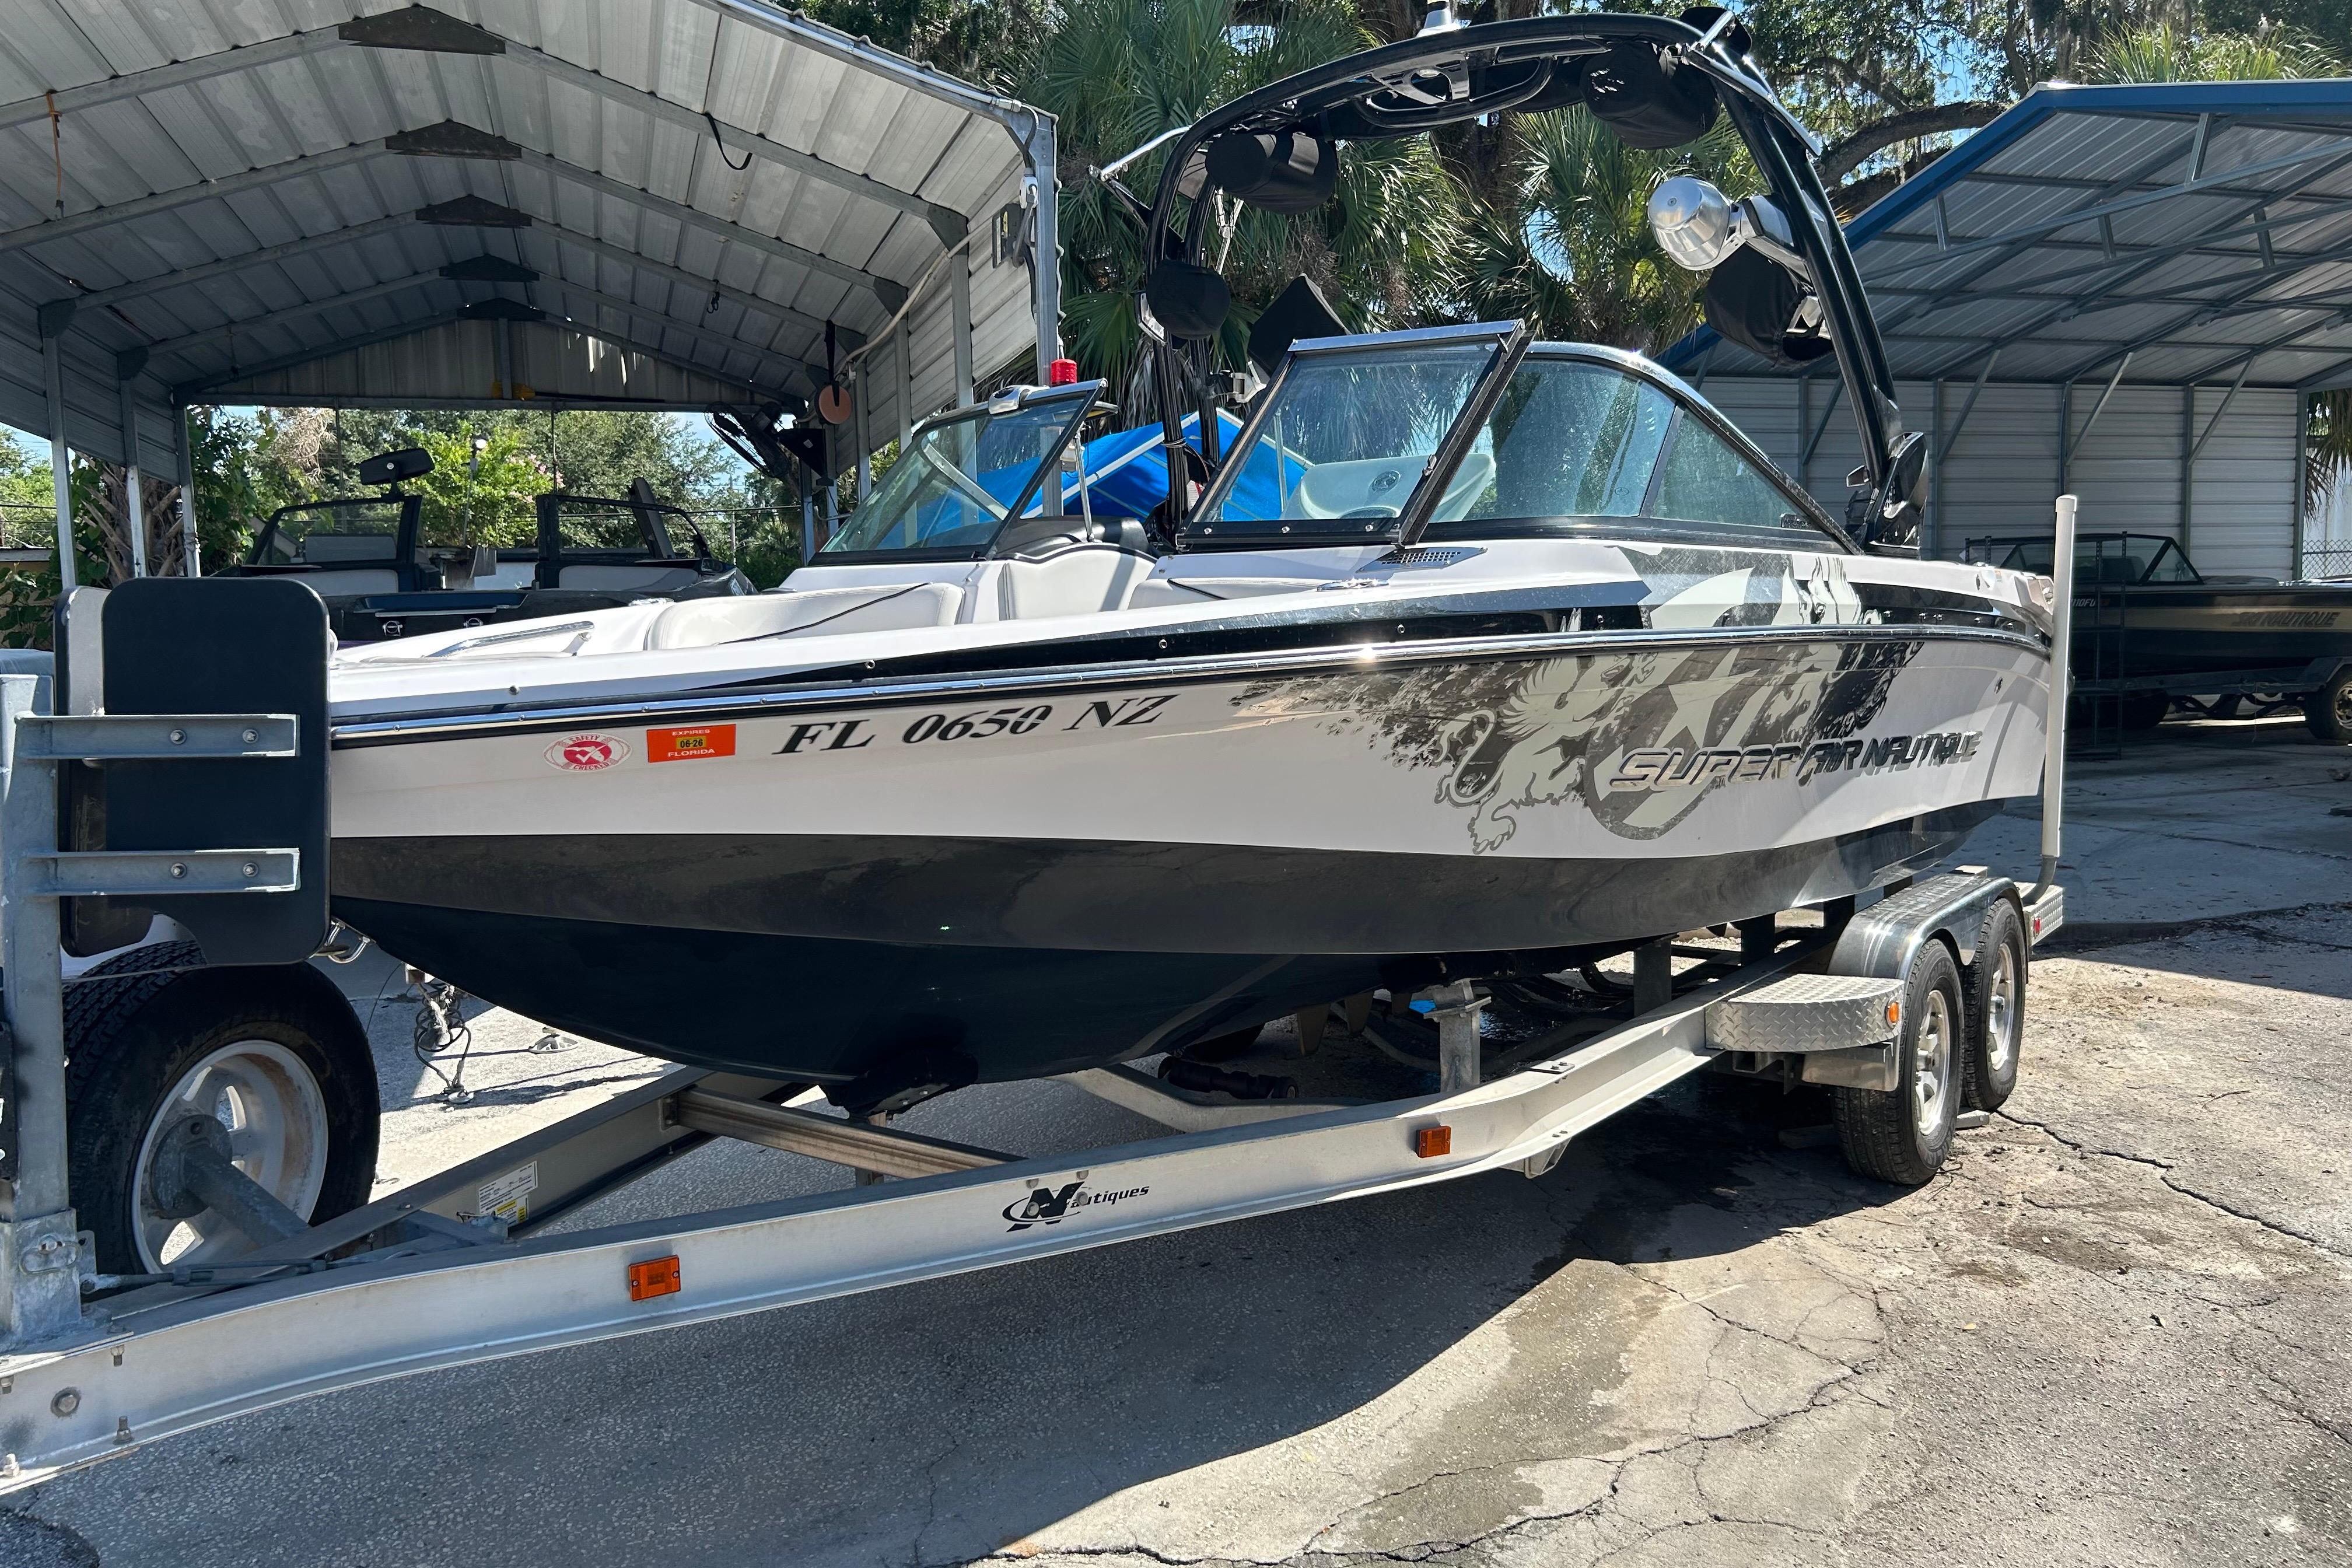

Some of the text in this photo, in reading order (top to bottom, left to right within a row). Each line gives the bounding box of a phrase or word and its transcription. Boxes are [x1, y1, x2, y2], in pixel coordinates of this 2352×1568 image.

[2260, 611, 2340, 627] NAUTIQUE
[771, 694, 1181, 755] FL 0650 NZ
[680, 738, 703, 748] 06-26
[667, 748, 715, 757] FLORIDA
[1609, 730, 1982, 789] SUPER AIR NAUTIQUE
[573, 762, 610, 771] CHECKED
